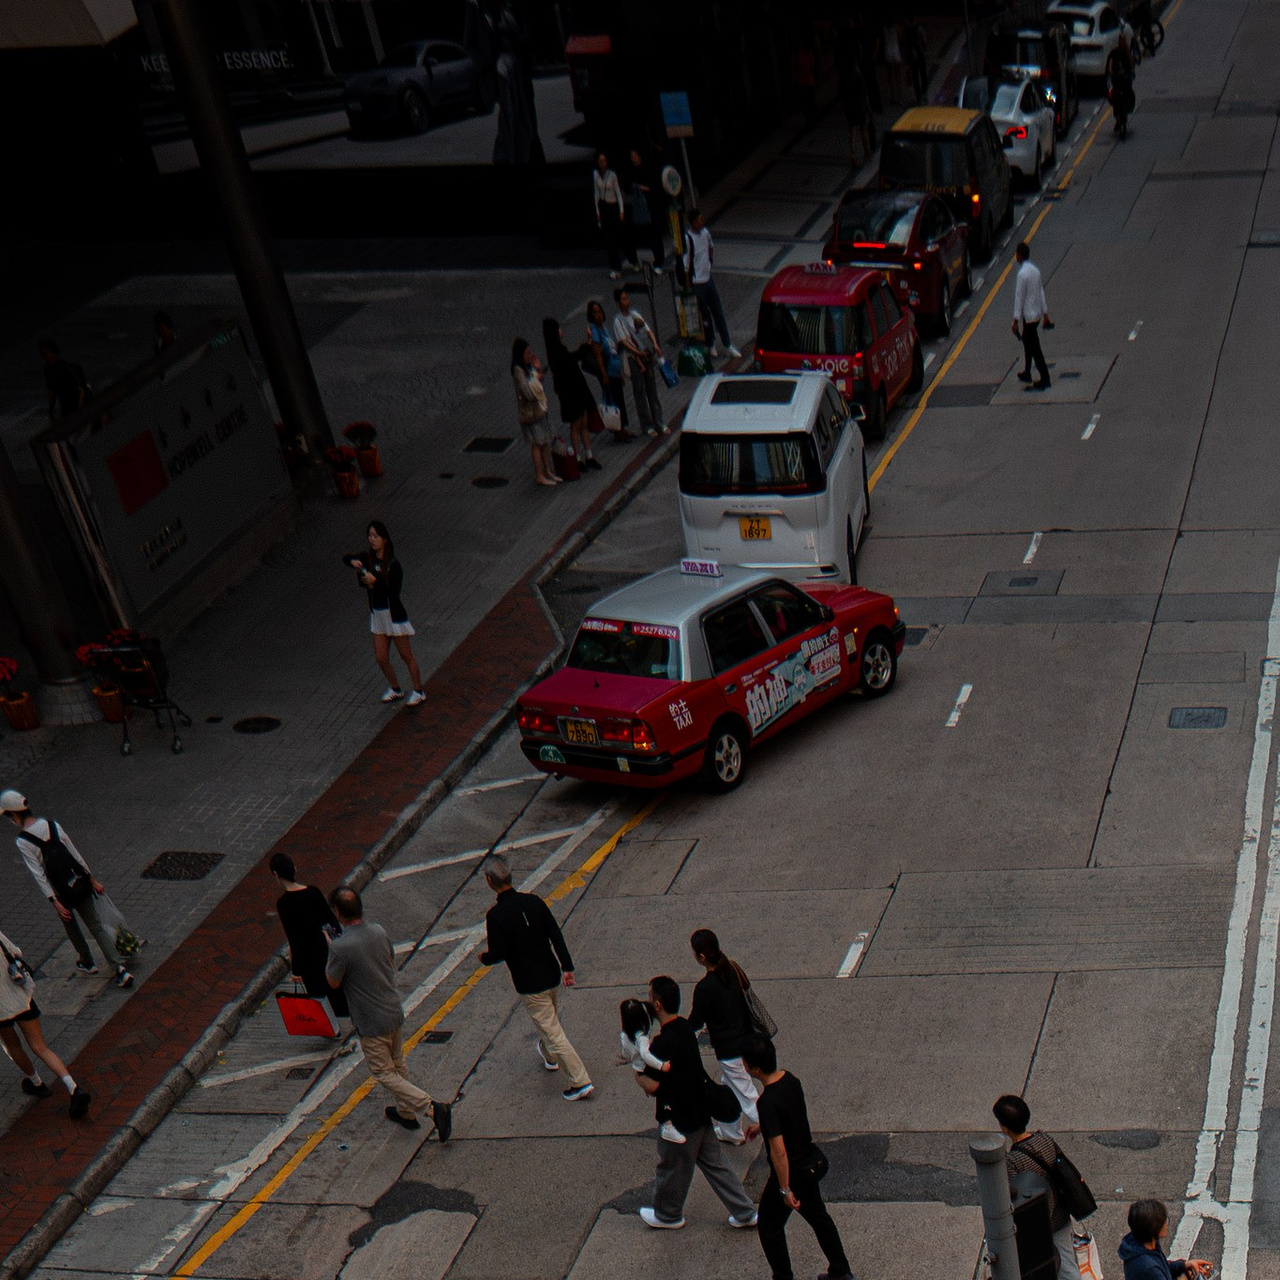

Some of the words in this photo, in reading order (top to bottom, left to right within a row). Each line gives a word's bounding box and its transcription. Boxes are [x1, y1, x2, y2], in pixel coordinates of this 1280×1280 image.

[223, 50, 295, 70] ESSENCE.
[749, 520, 761, 529] ZT
[744, 529, 767, 539] 1897
[682, 561, 715, 574] TAXI
[668, 699, 689, 717] 的士
[673, 710, 693, 731] TAXI
